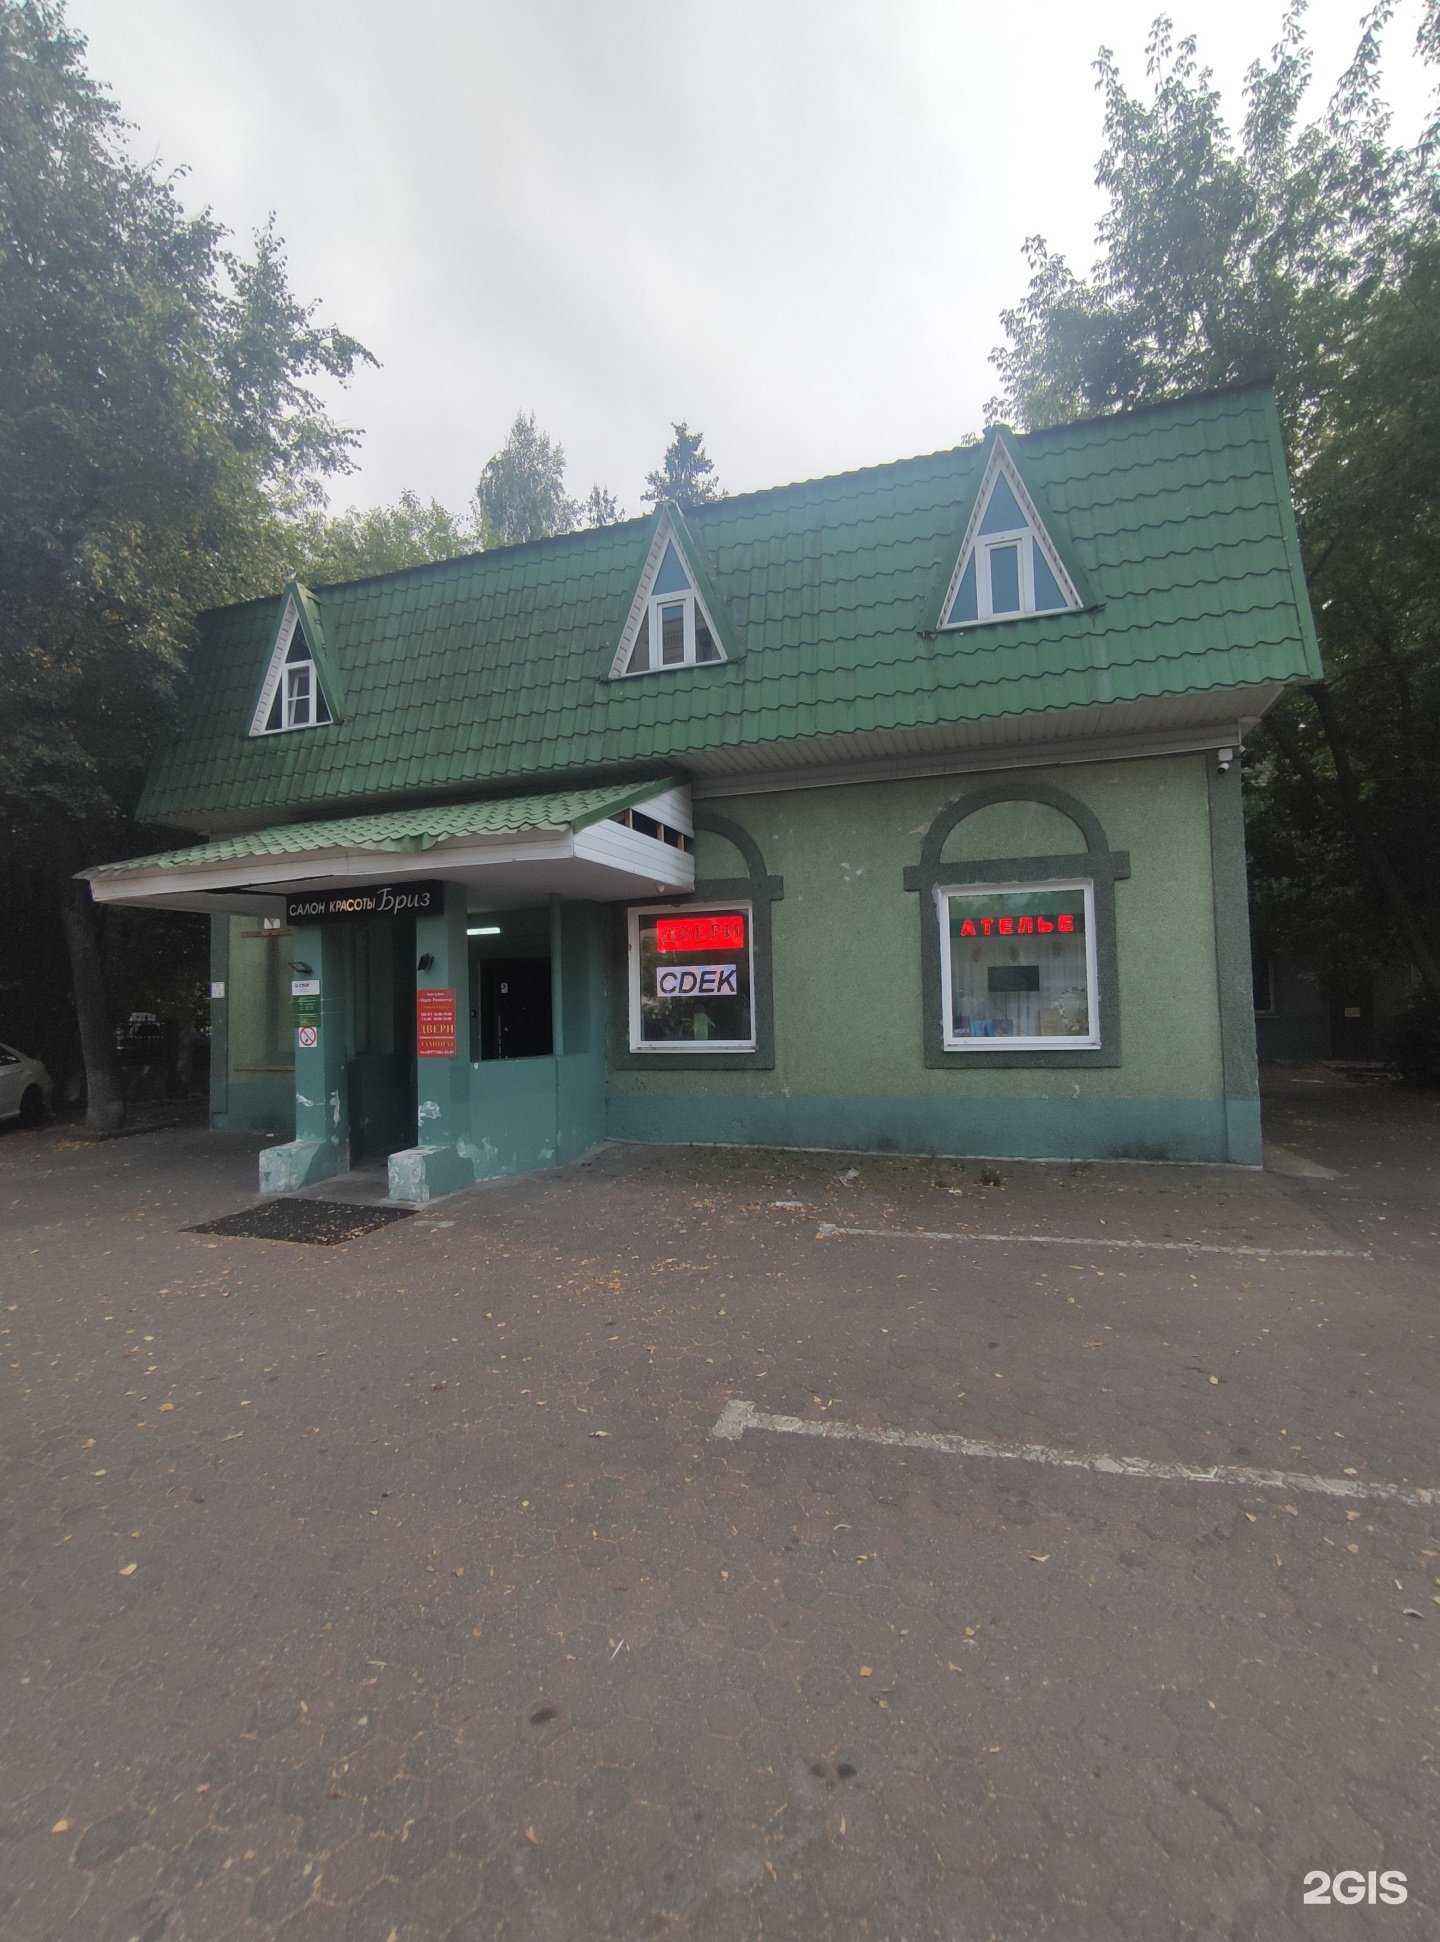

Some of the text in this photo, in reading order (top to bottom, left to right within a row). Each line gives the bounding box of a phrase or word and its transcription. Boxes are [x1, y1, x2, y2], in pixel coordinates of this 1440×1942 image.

[289, 887, 431, 916] САЛОН КРАСОТЫ Бриз
[960, 914, 1074, 936] АТЕЛЬЕ
[660, 969, 736, 994] CDEK
